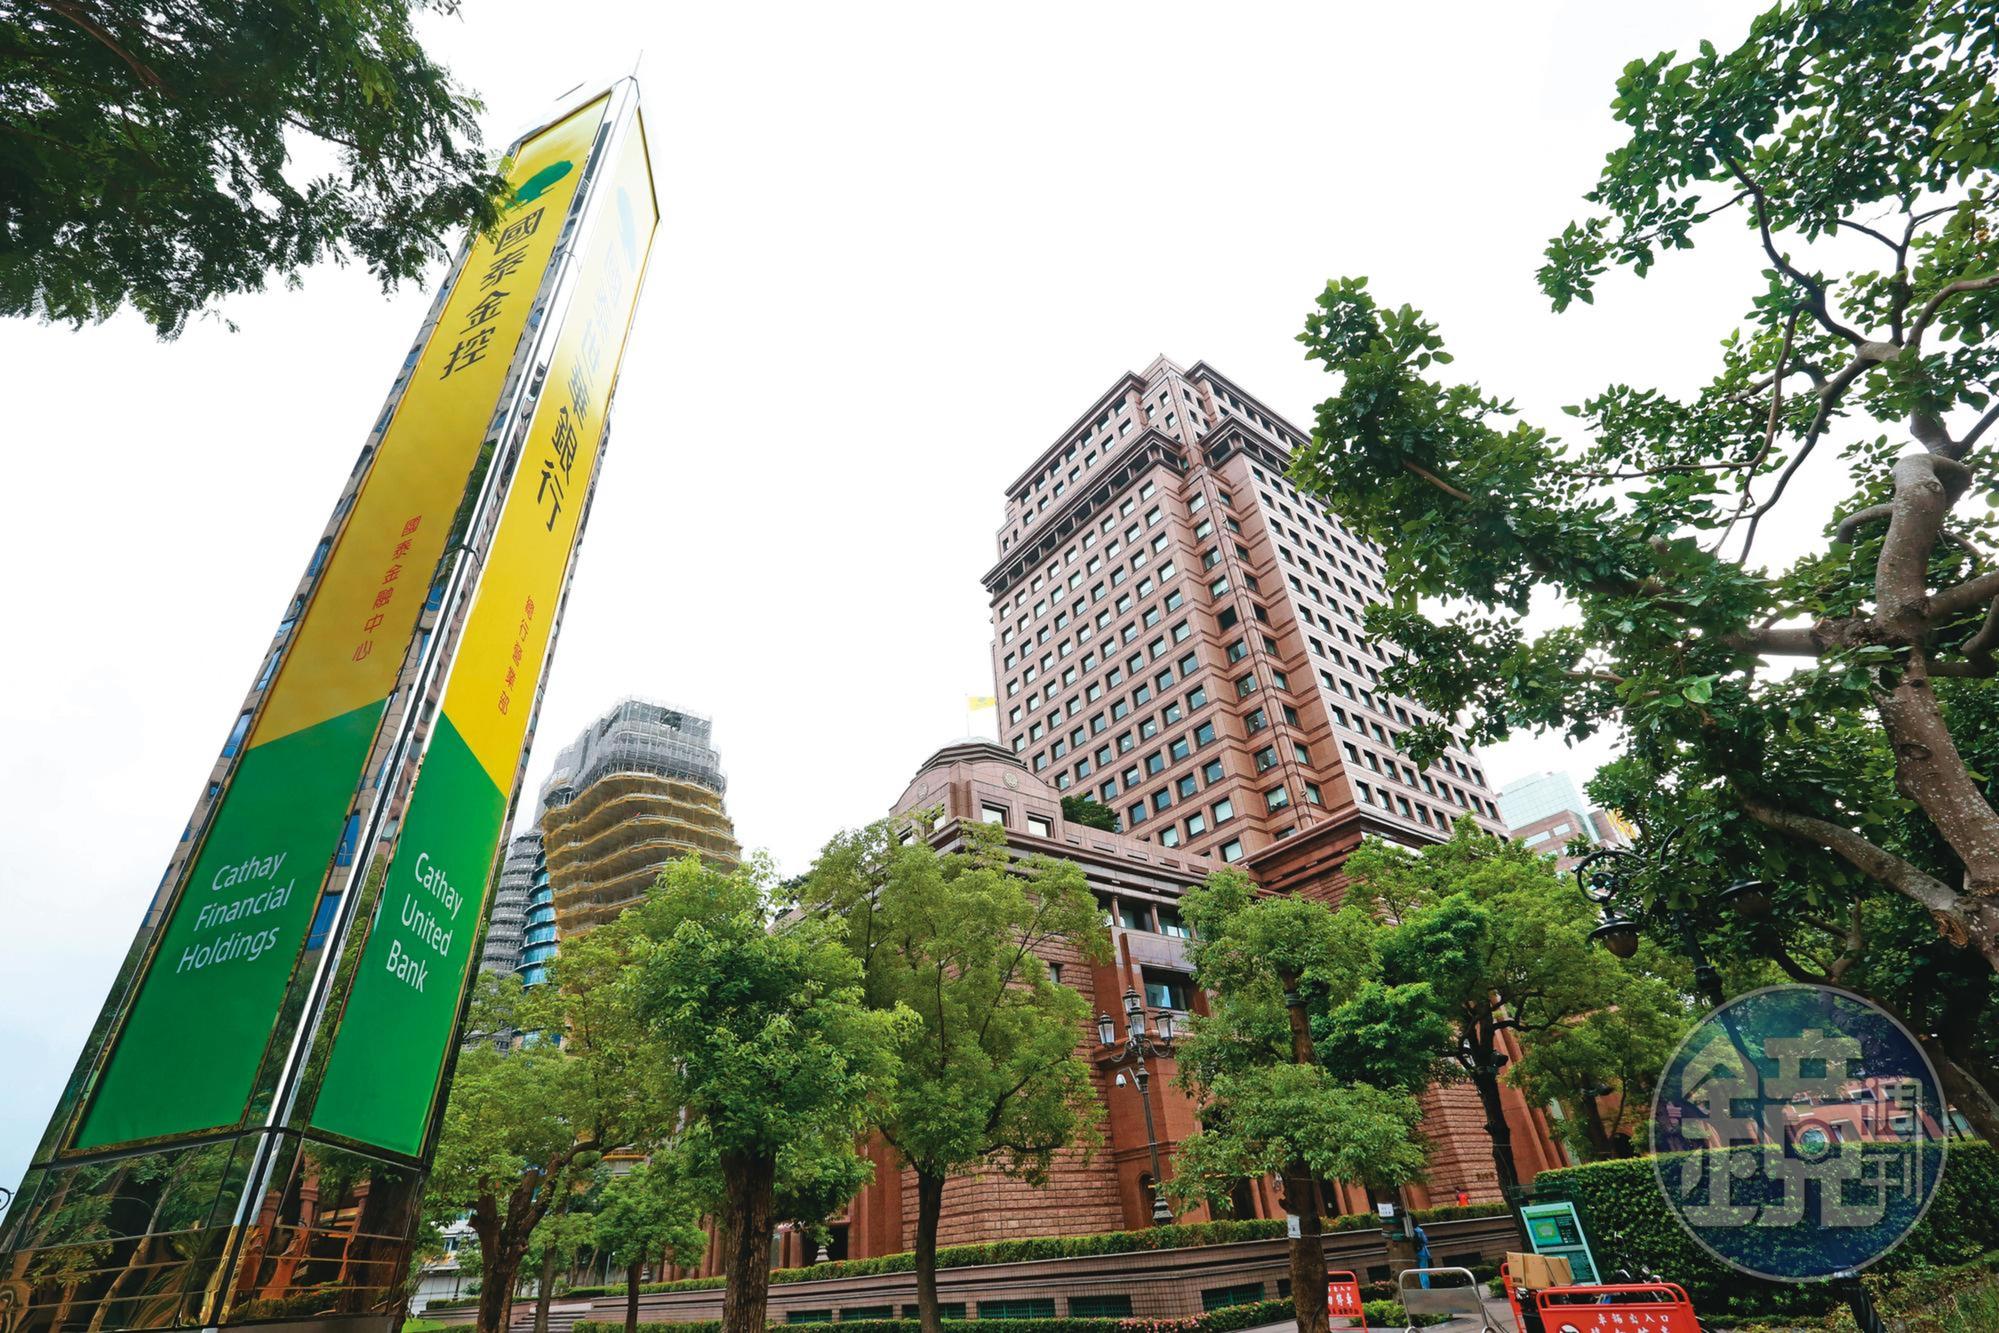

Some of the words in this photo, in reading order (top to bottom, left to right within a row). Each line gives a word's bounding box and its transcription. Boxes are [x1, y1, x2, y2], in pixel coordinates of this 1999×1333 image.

[440, 206, 545, 380] 國泰金控
[352, 515, 422, 662] 國泰金融中心
[211, 852, 287, 892] Cathay
[414, 852, 463, 920] Cathay
[193, 878, 295, 932] Financial
[401, 893, 453, 957] United
[176, 926, 280, 974] Holdings
[386, 939, 429, 993] Bank
